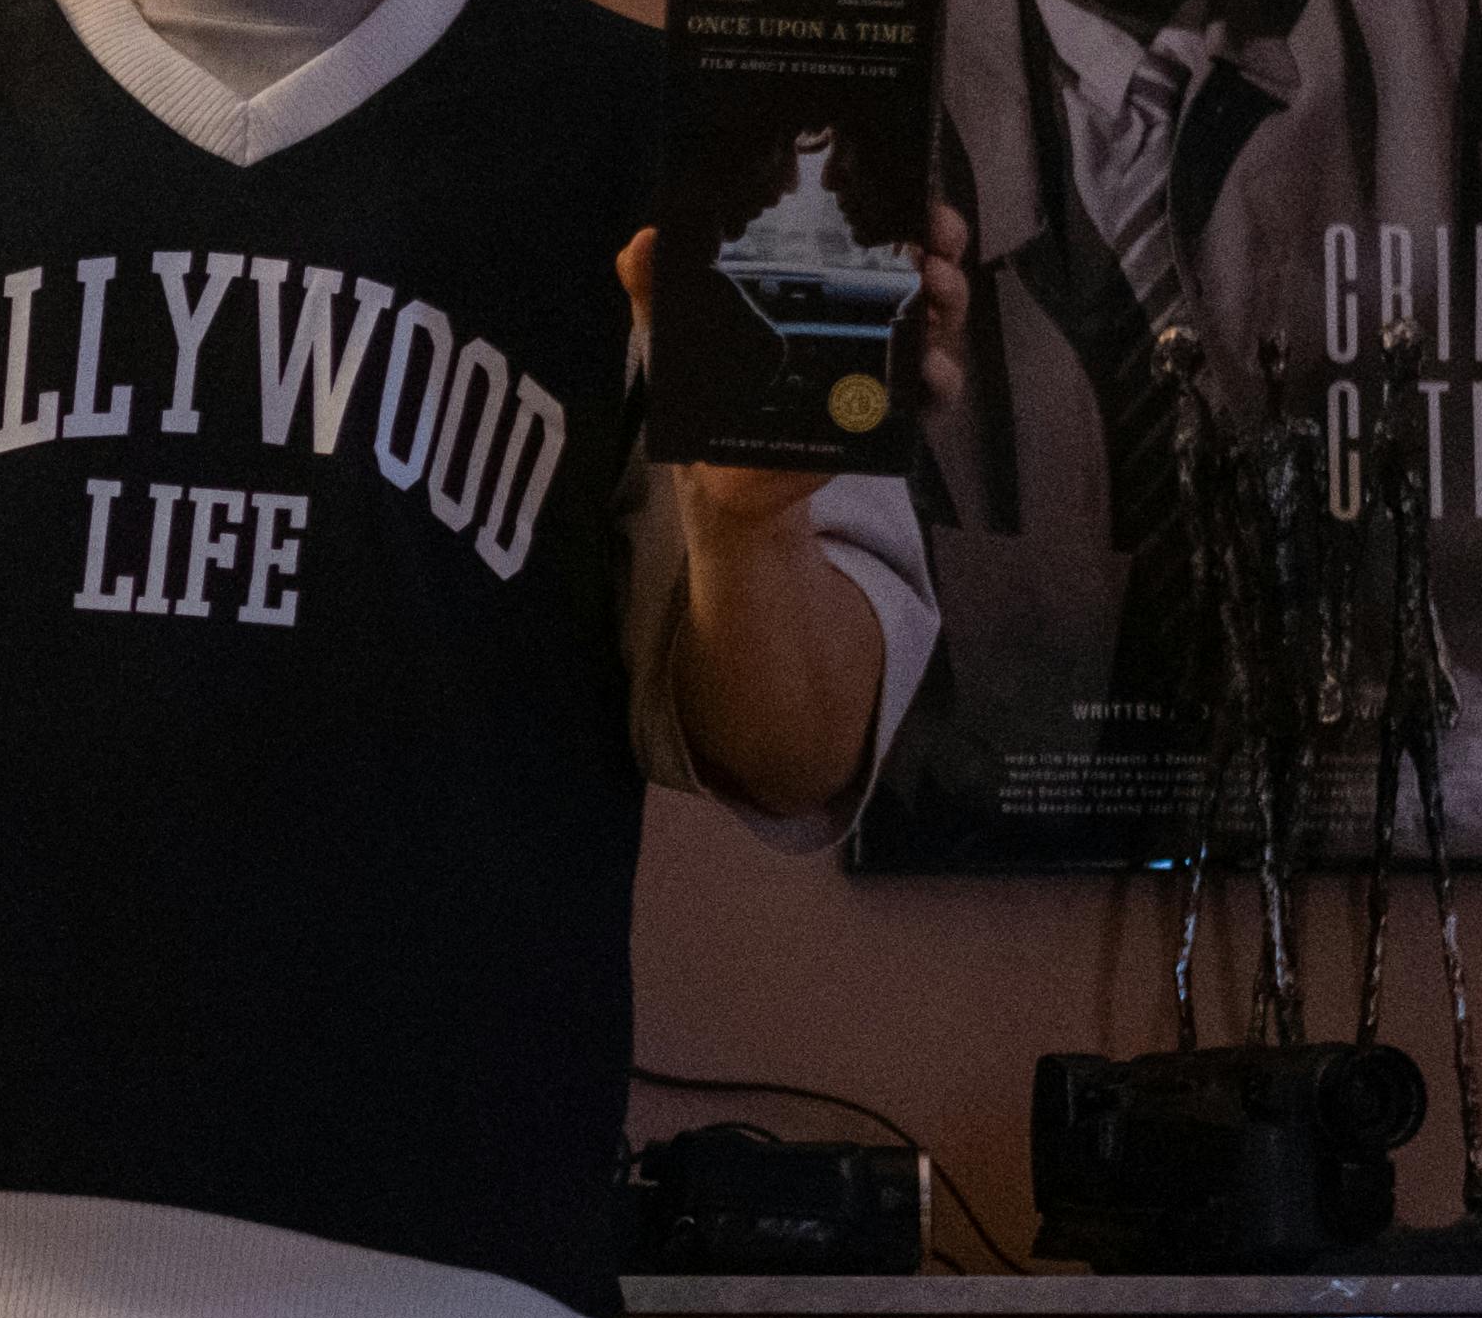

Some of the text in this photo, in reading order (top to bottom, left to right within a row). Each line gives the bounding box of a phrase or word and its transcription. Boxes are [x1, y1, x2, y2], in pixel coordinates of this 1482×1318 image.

[686, 14, 917, 45] ONCE UPON A TIME
[73, 477, 309, 627] LIFE
[1071, 701, 1163, 722] WRITTEN
